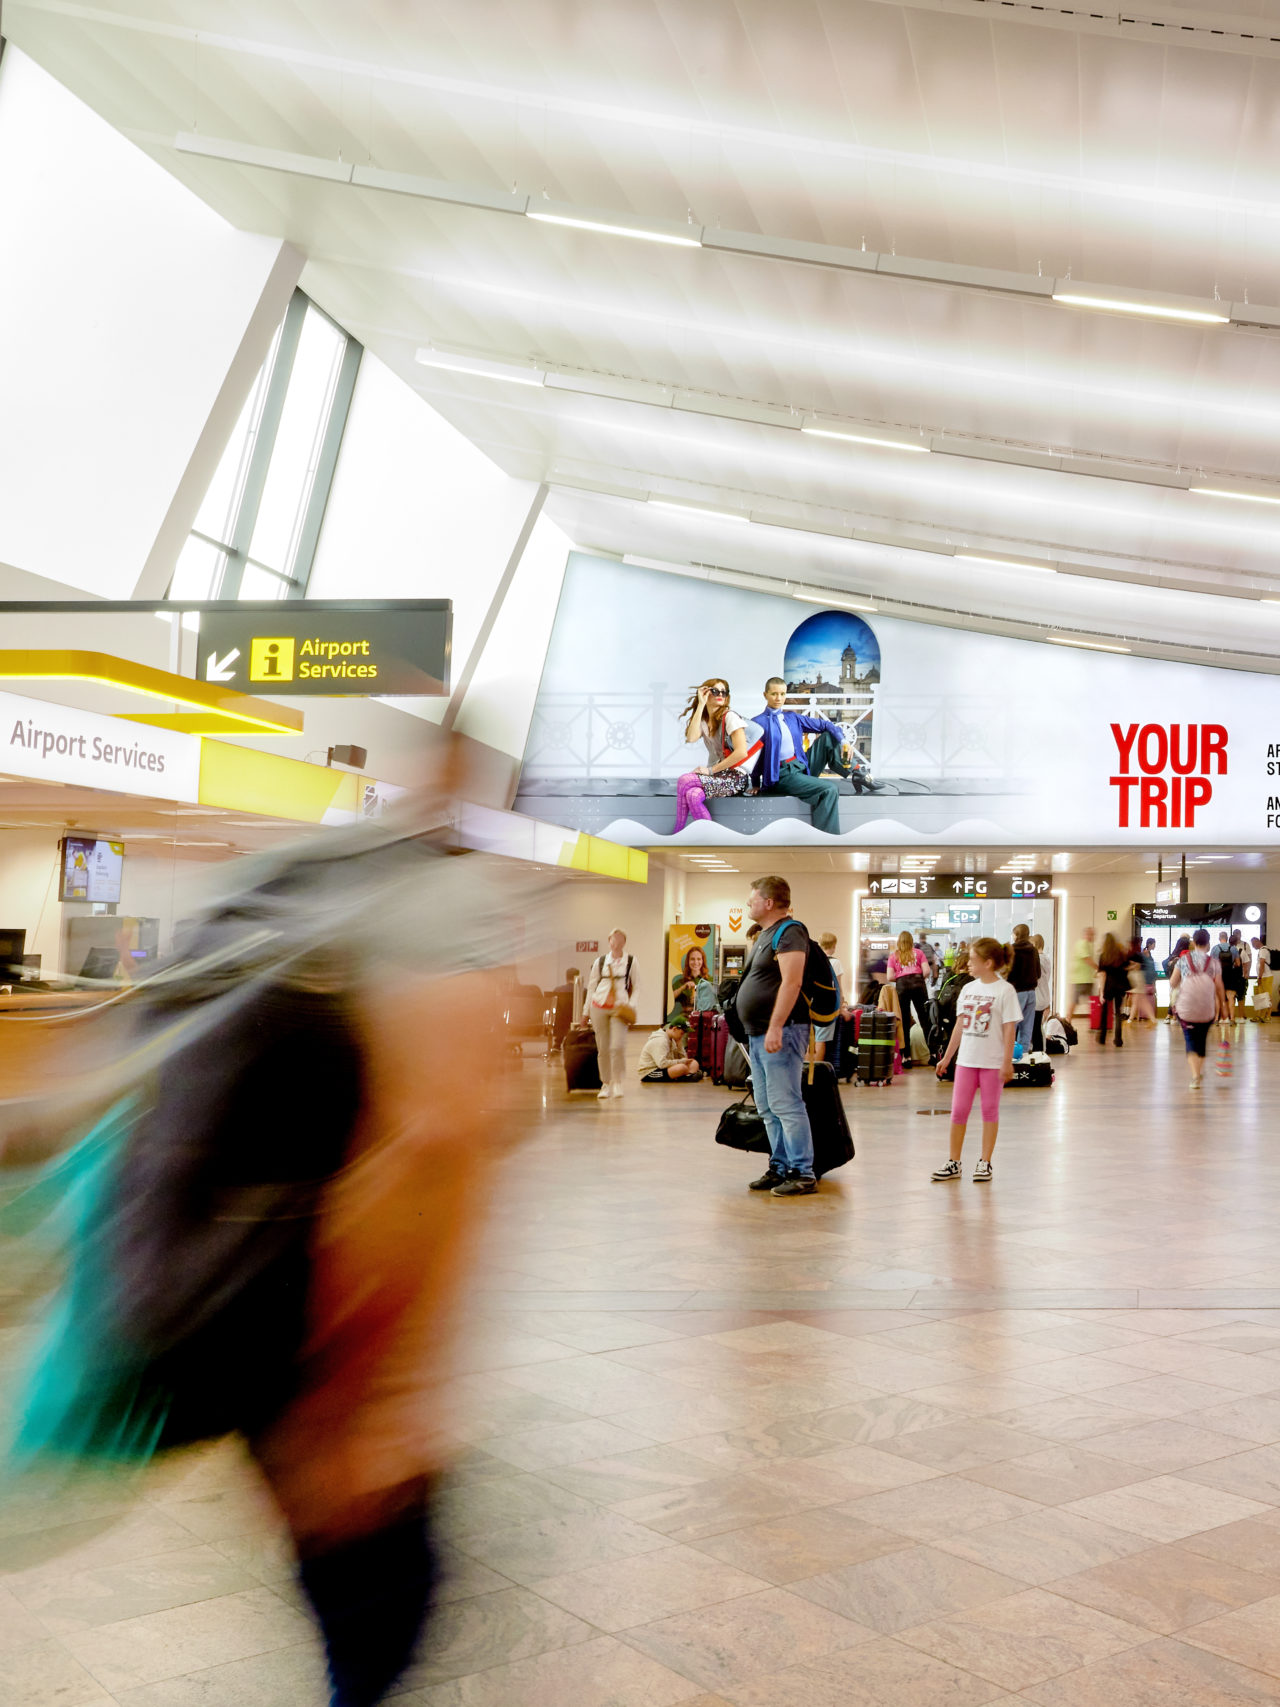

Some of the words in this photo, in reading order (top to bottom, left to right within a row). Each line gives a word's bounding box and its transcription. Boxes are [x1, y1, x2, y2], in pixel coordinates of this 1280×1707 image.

[300, 639, 370, 660] Airport
[299, 662, 377, 678] Services
[10, 720, 86, 759] Airport
[92, 737, 165, 773] Services
[1109, 723, 1228, 775] YOUR
[1109, 776, 1212, 828] TRIP
[920, 881, 928, 893] 3
